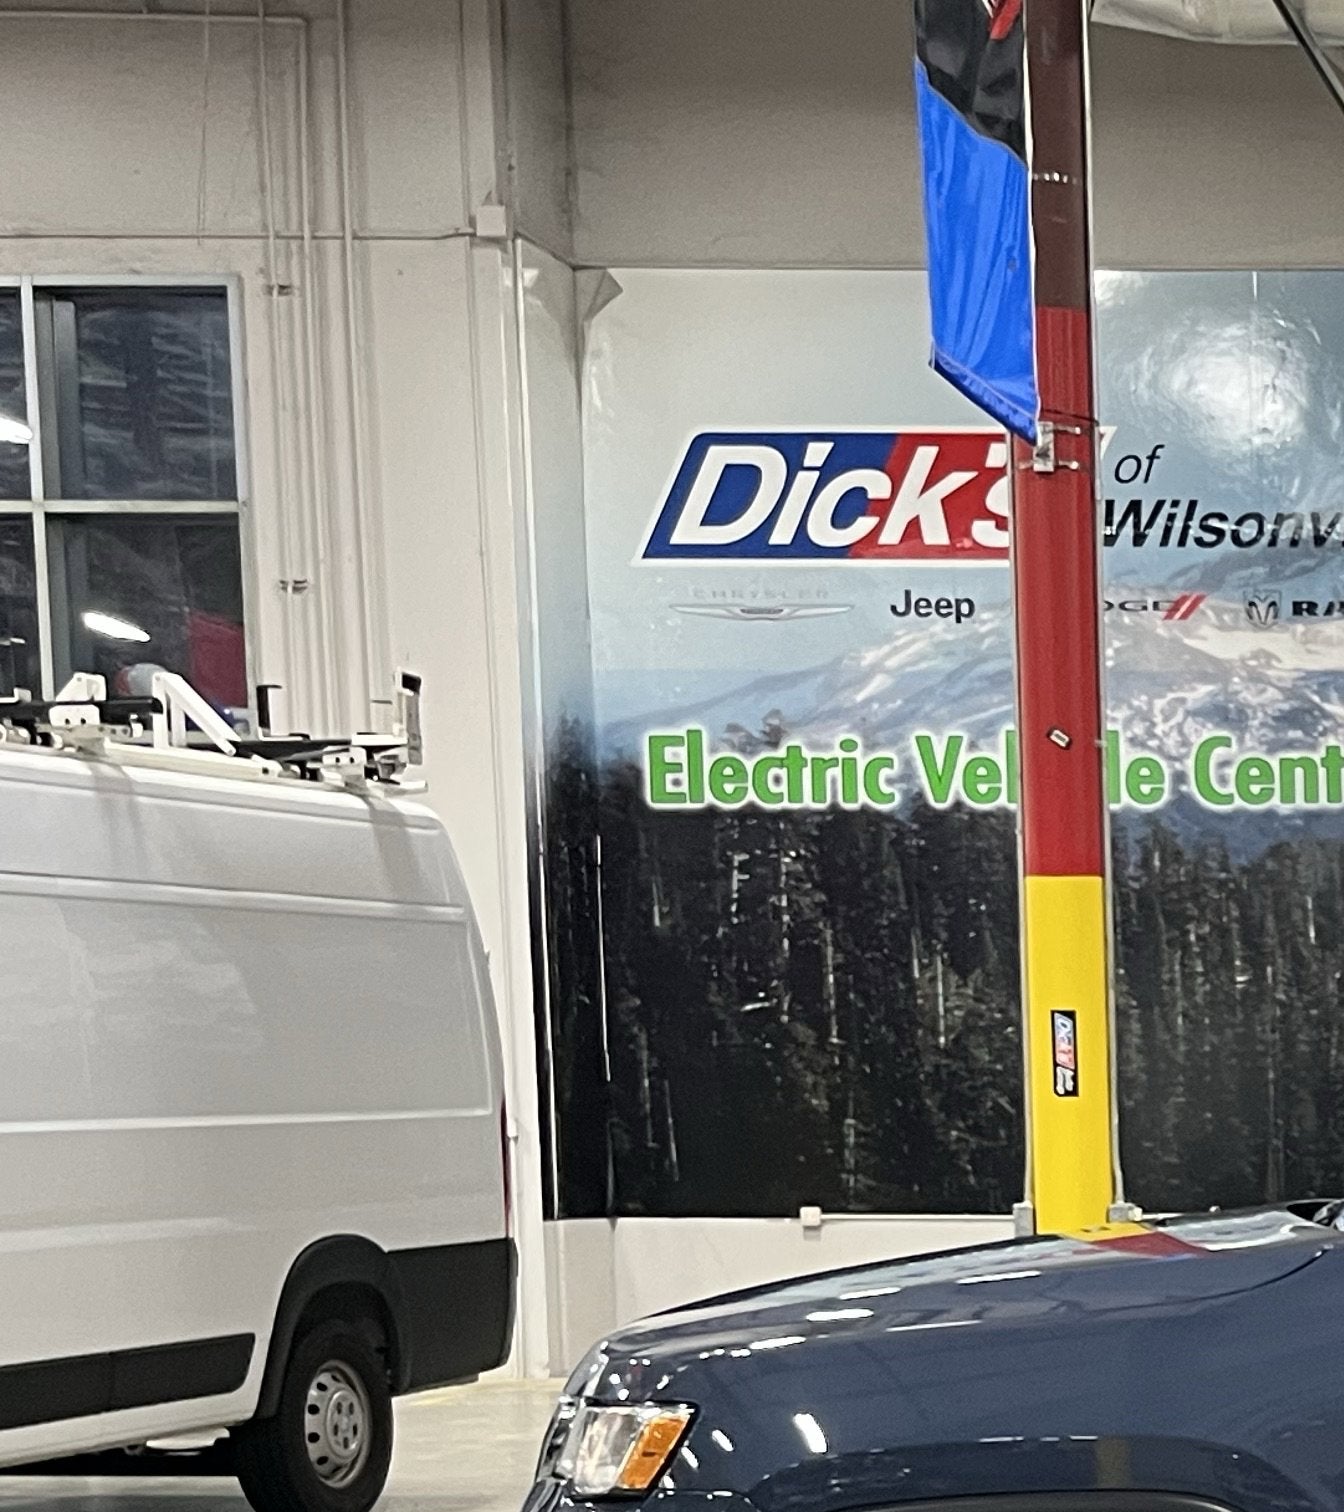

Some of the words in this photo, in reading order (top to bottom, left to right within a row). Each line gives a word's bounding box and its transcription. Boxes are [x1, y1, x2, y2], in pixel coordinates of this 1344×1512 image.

[1113, 444, 1165, 485] of
[889, 588, 976, 624] Jeep
[647, 728, 897, 806] Electric
[914, 729, 1167, 806] Vele
